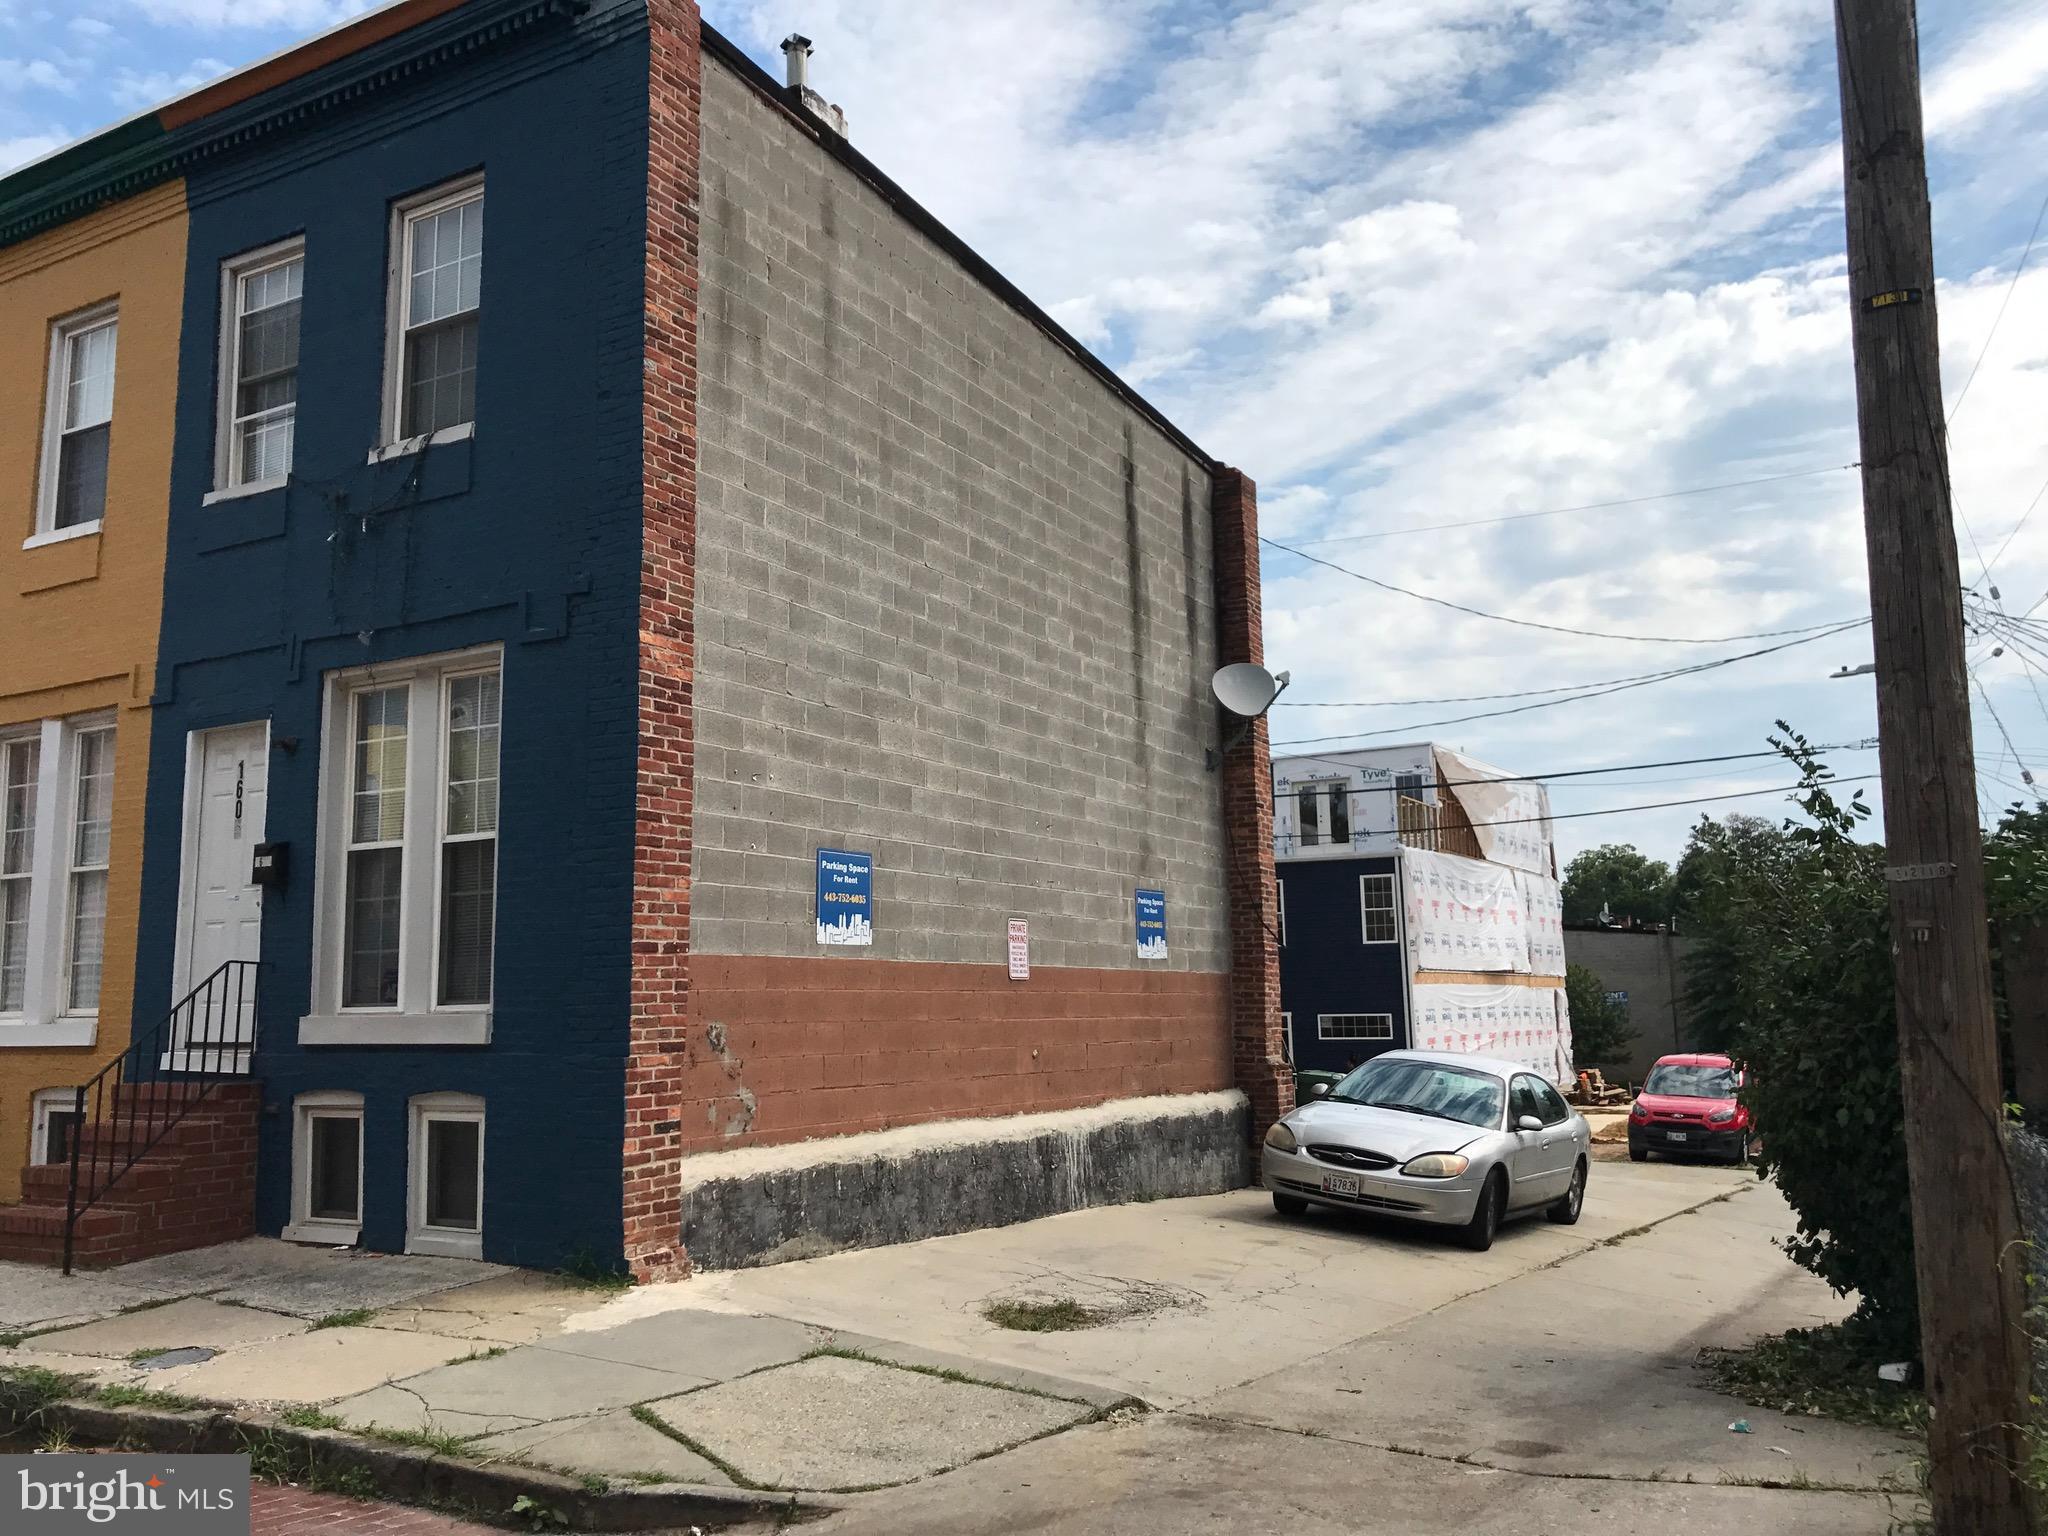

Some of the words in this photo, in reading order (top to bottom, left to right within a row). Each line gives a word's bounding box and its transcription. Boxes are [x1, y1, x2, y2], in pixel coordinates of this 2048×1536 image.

[822, 860, 847, 873] Parking
[848, 863, 868, 874] Space
[833, 874, 842, 882] For
[844, 876, 858, 884] Rent
